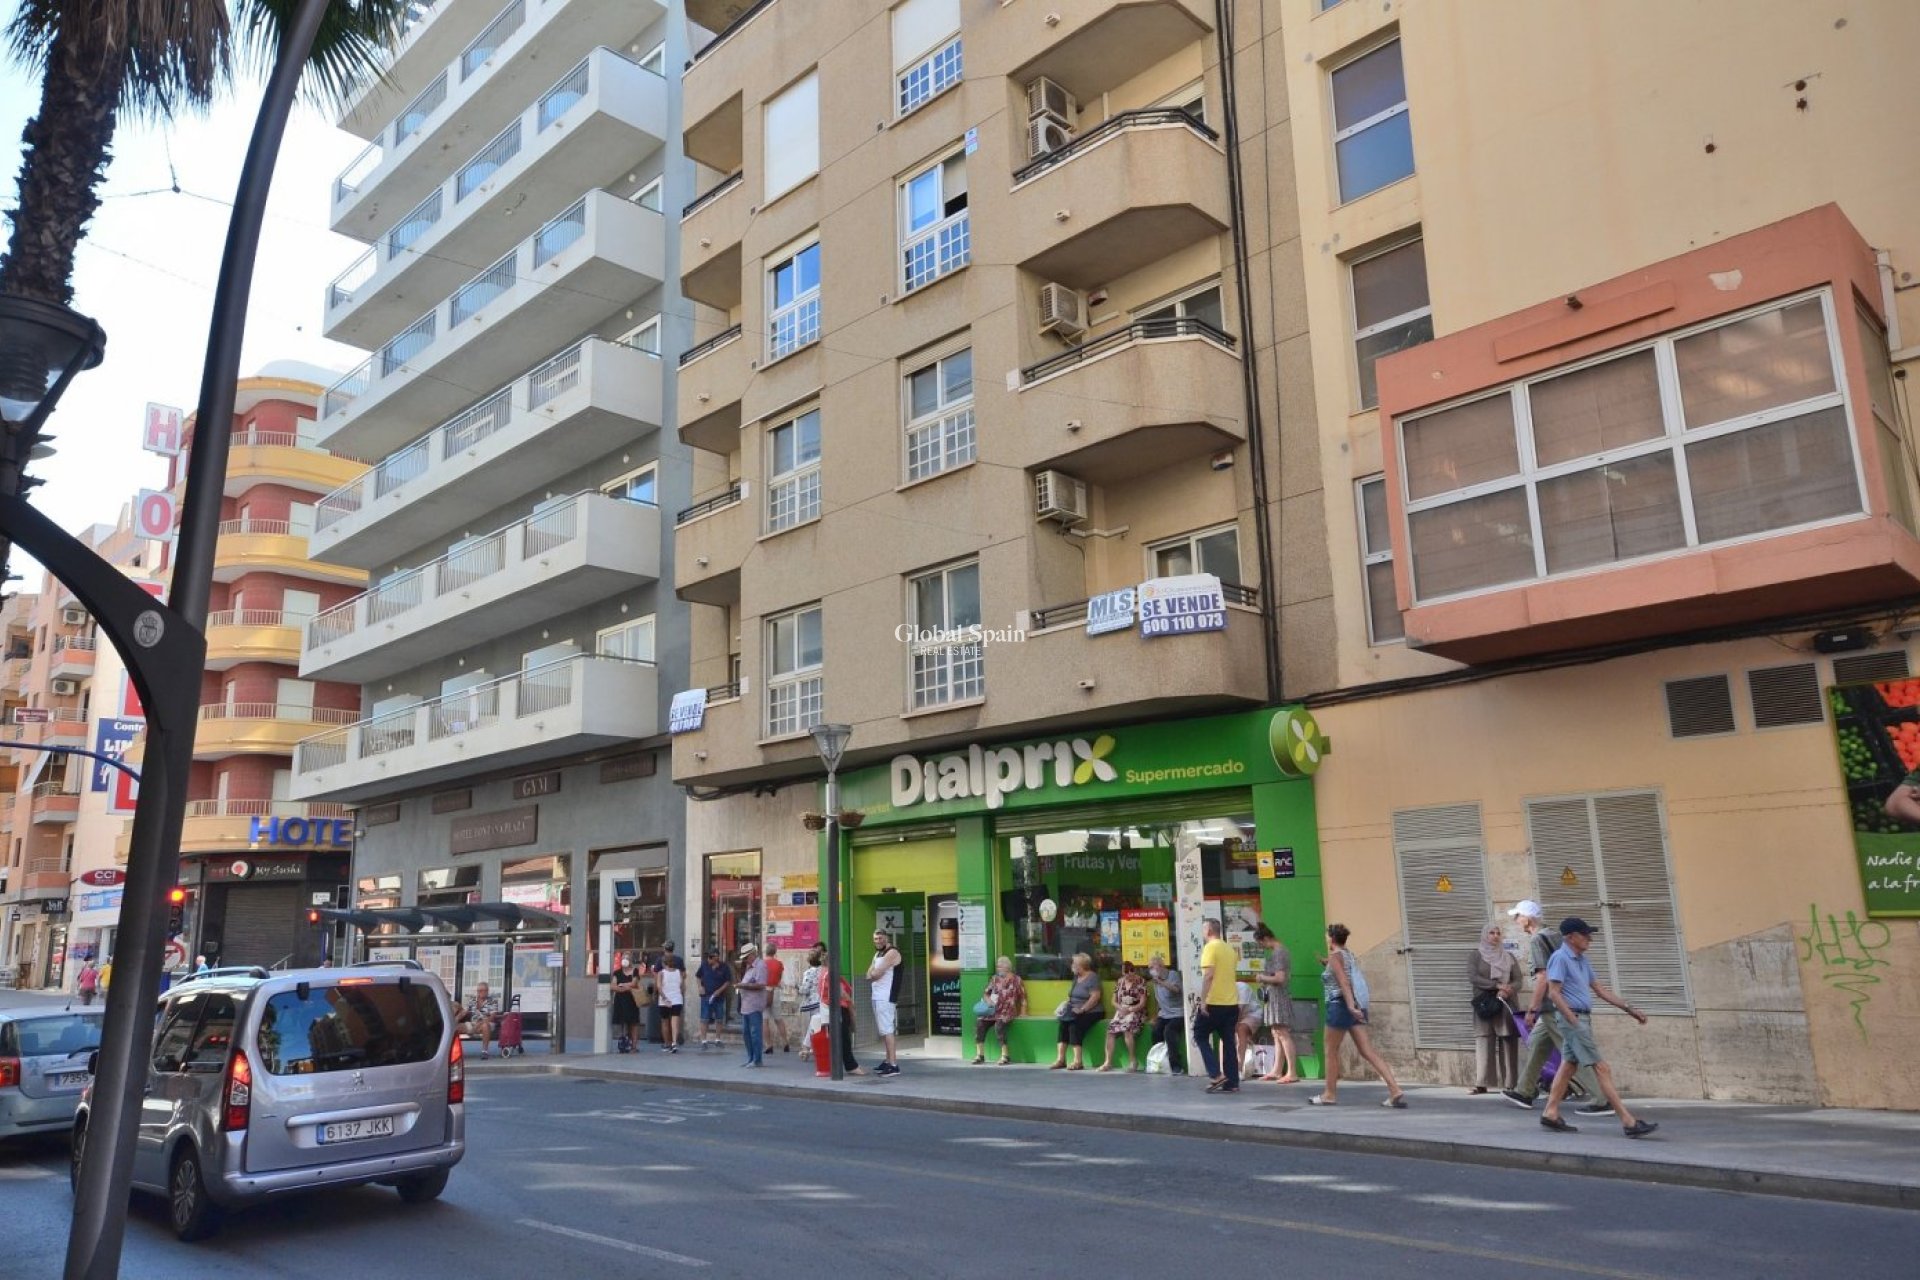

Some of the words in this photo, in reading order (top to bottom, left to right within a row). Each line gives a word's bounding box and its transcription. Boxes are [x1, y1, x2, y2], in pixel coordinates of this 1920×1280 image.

[1091, 593, 1131, 618] MLS
[1142, 600, 1162, 618] SE
[1165, 594, 1220, 613] VENDE
[1143, 618, 1169, 634] 600
[1171, 615, 1194, 630] 110
[1197, 613, 1223, 628] 073
[890, 735, 1118, 809] Dialprix
[1125, 759, 1245, 785] Supermercado
[1063, 854, 1105, 870] Frutas
[1866, 852, 1913, 867] Nadie
[326, 1123, 361, 1139] 6137
[366, 1118, 391, 1135] JKK
